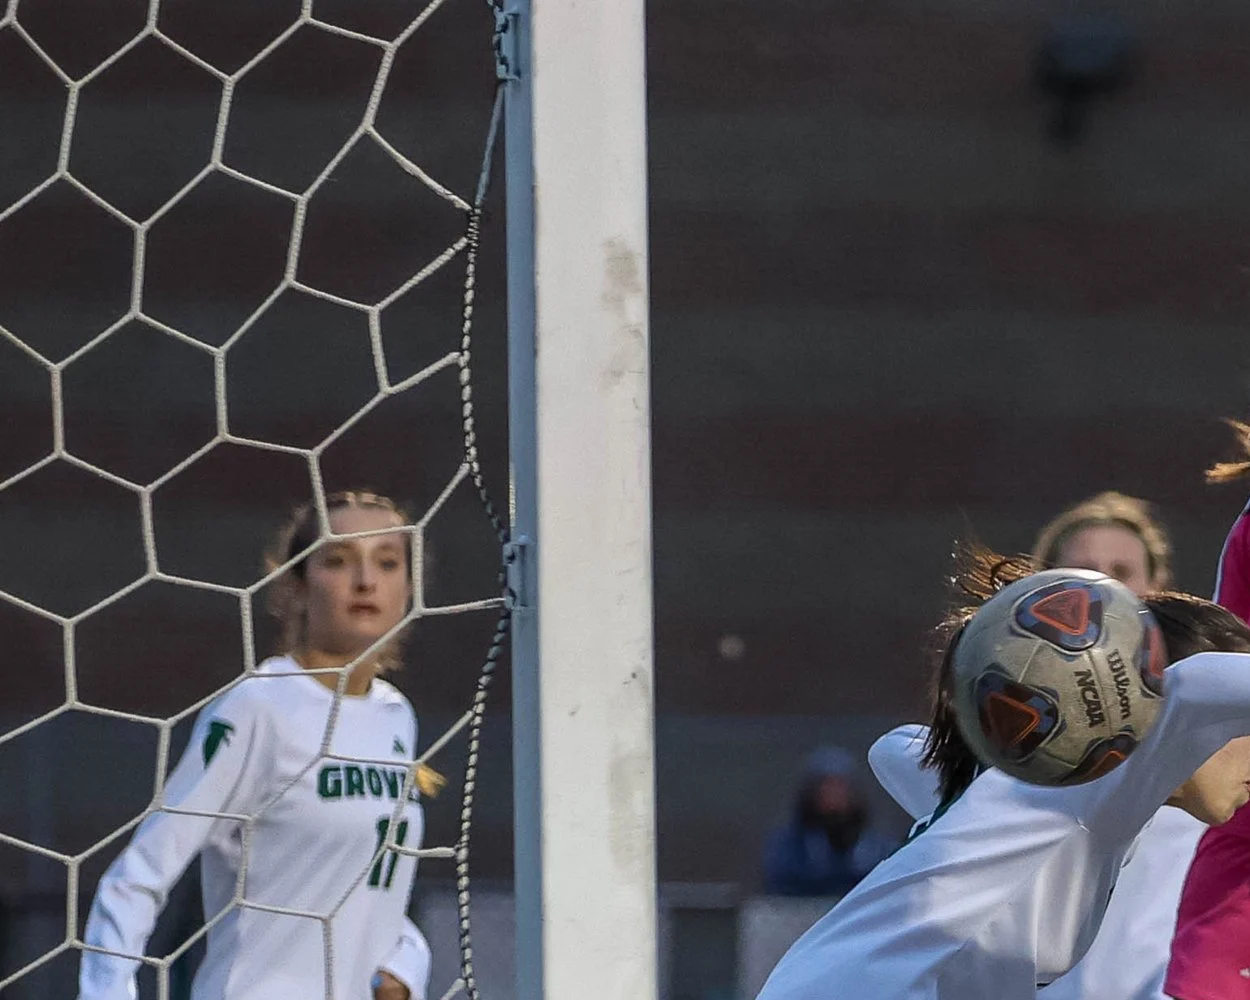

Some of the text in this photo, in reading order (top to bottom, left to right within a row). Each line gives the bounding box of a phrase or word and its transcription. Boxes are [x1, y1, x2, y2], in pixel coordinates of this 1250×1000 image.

[1074, 669, 1105, 728] NCAA
[1106, 648, 1131, 720] Wilson
[317, 765, 420, 800] GROV
[367, 818, 408, 888] 11
